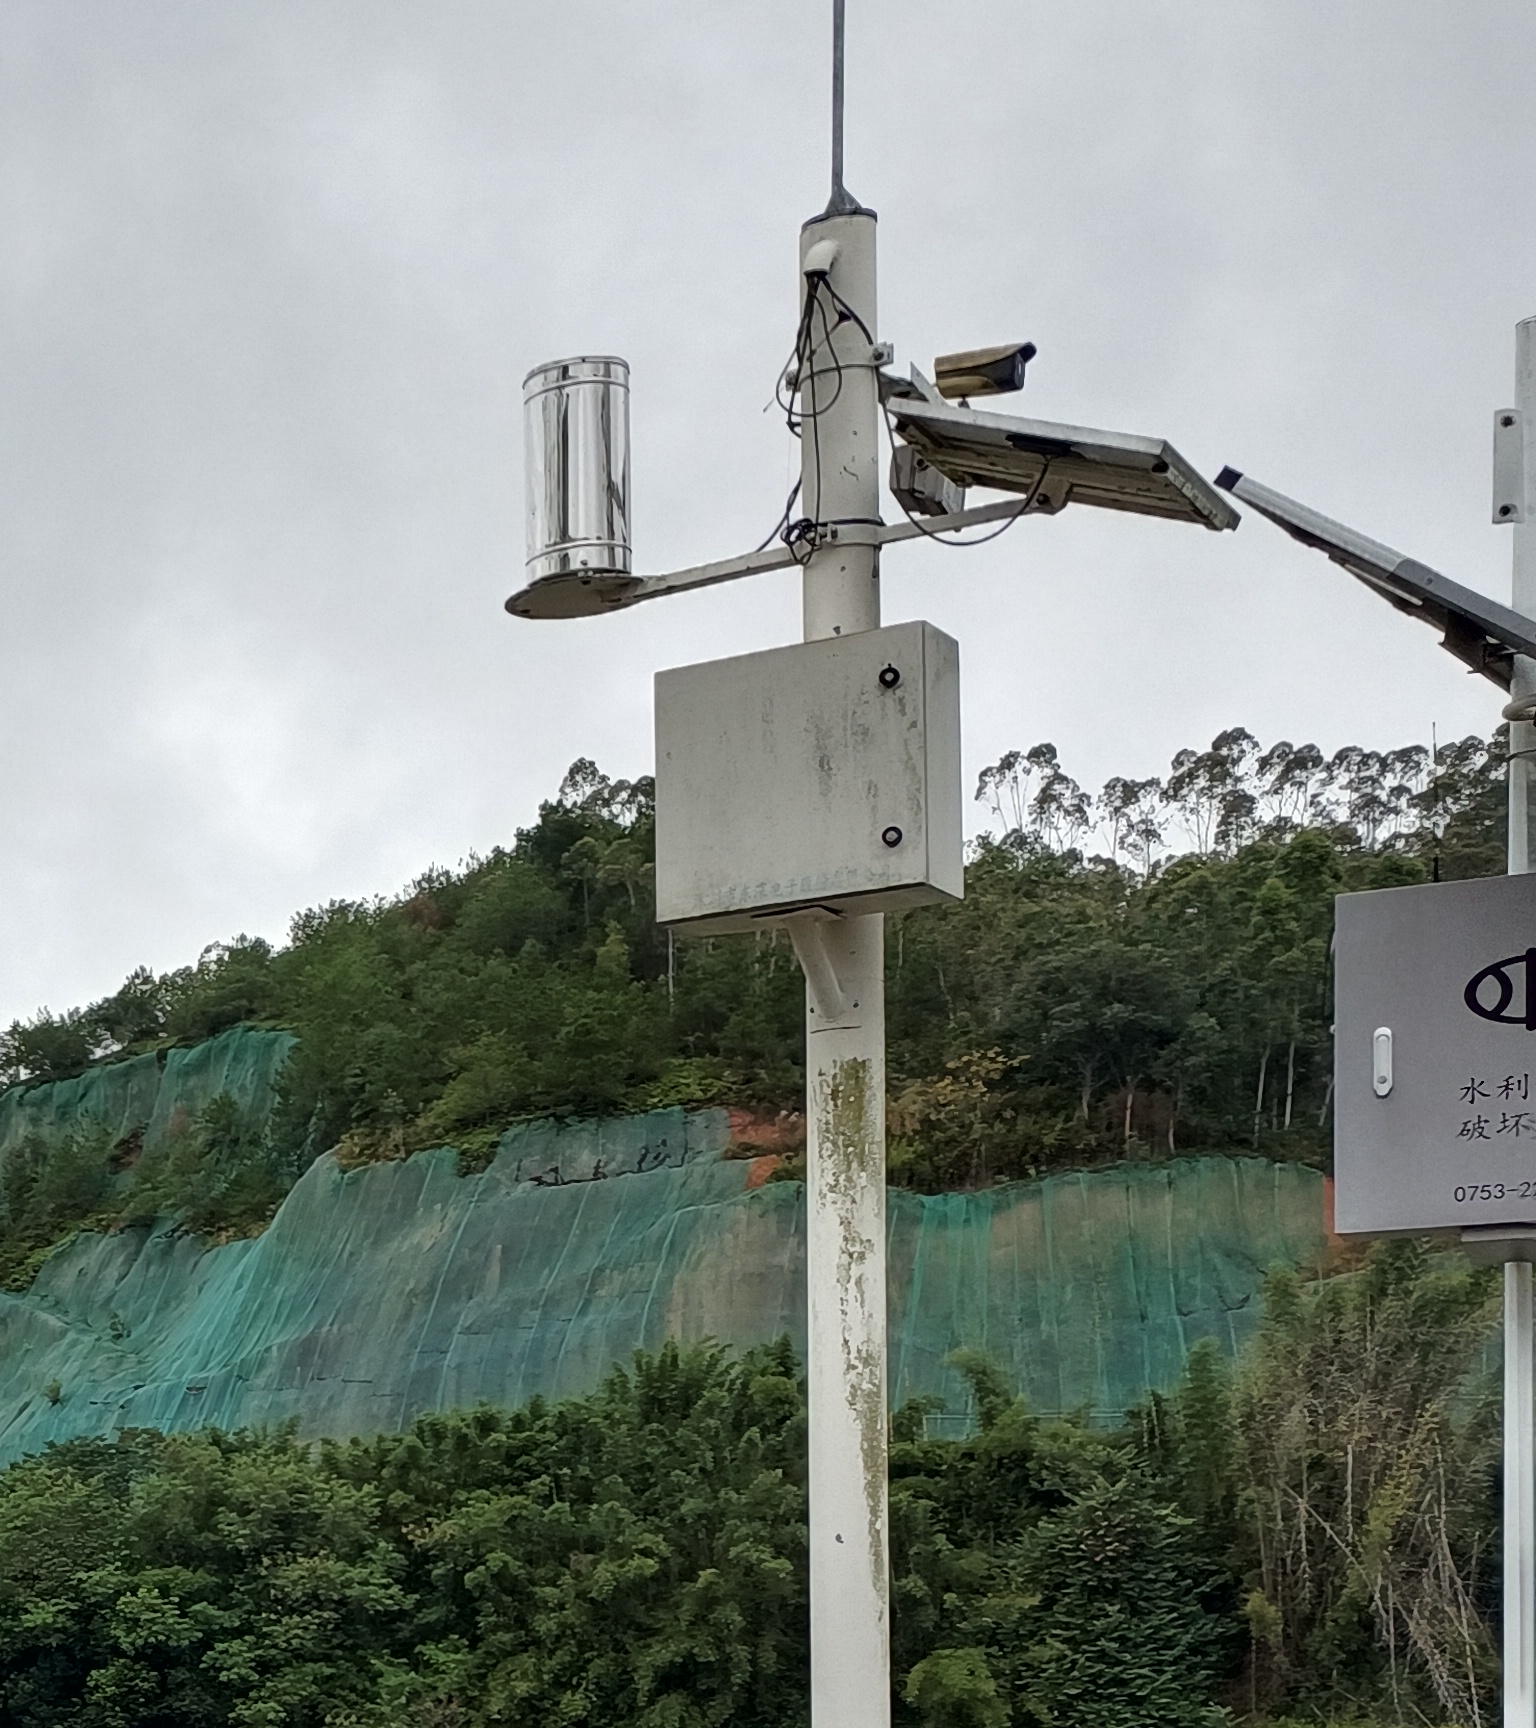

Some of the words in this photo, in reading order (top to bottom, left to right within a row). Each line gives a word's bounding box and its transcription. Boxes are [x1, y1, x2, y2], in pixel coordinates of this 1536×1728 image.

[1458, 1073, 1536, 1105] 水利
[1455, 1112, 1536, 1142] 破坏
[1453, 1181, 1536, 1202] 0753-2
